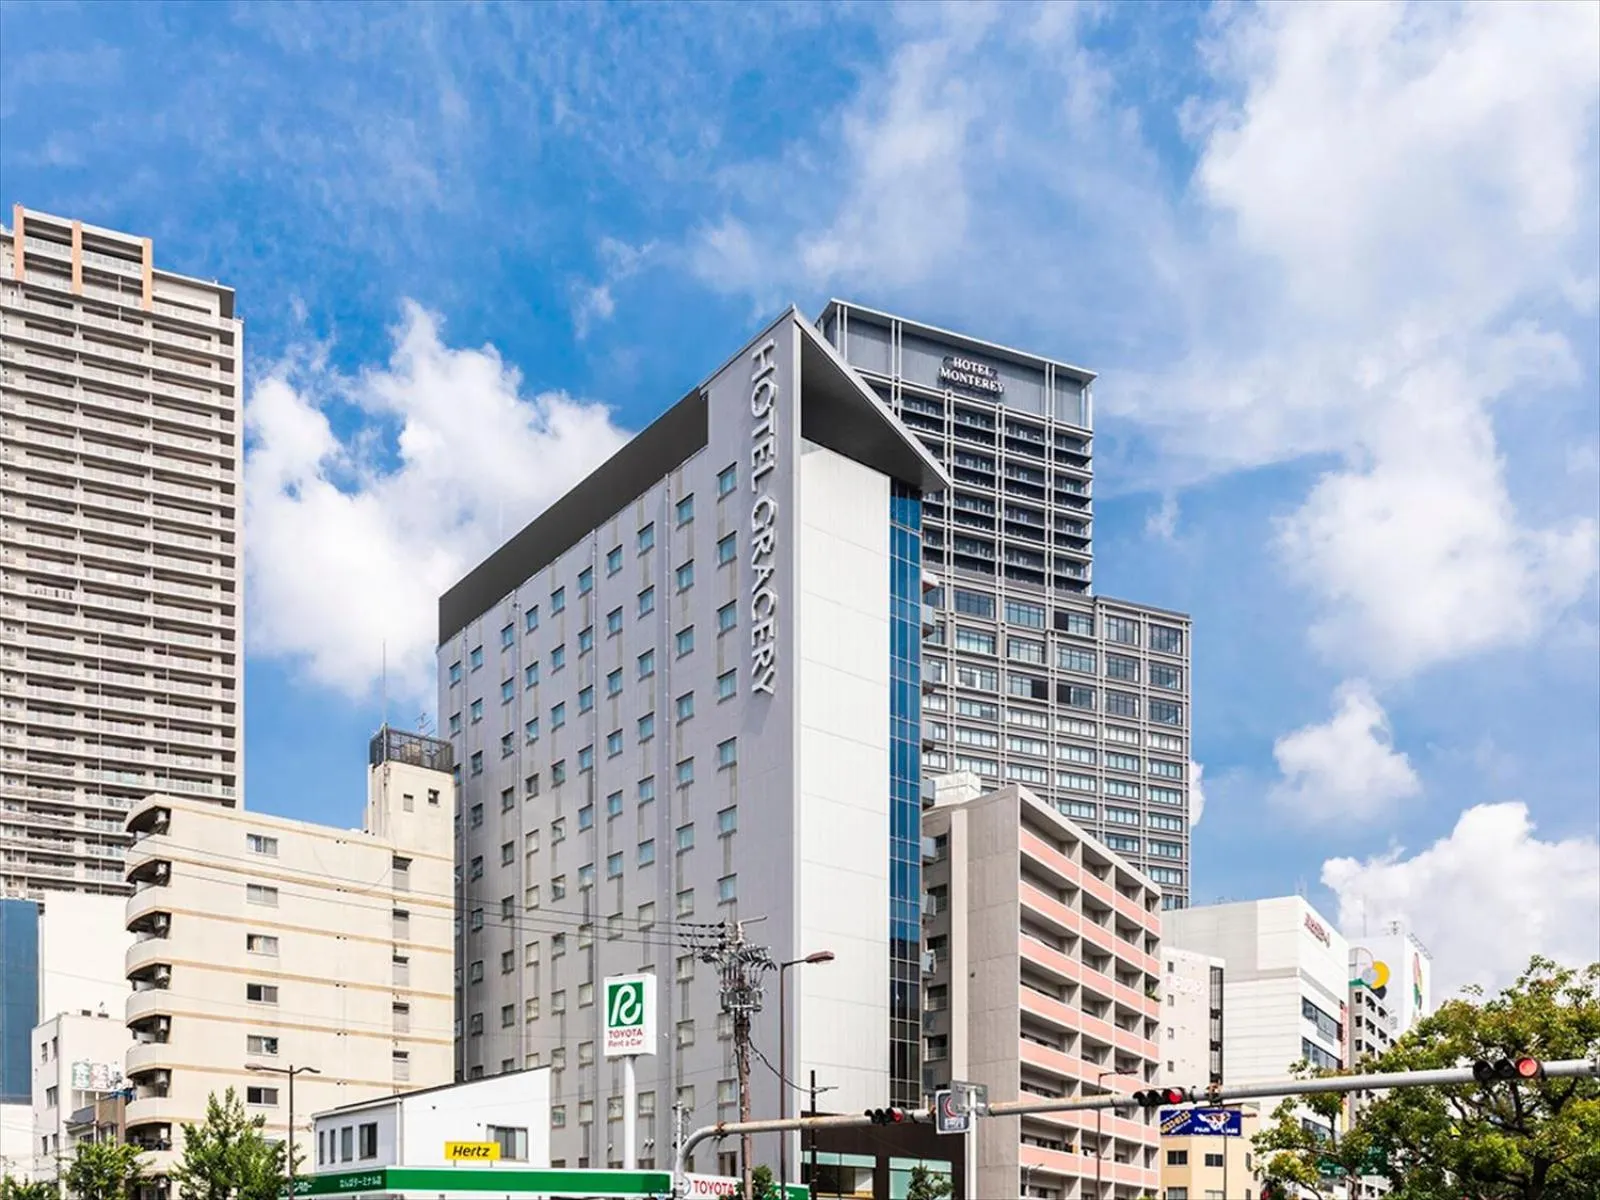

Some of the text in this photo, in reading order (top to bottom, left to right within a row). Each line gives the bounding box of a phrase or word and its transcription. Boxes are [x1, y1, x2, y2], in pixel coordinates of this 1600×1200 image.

[953, 357, 993, 377] HOTEL
[940, 367, 1005, 392] MONTEREY
[752, 338, 777, 695] HOTEL GRACERY
[608, 1028, 643, 1039] TOYOTA
[608, 1039, 624, 1048] Rent
[630, 1038, 642, 1046] Car
[452, 1145, 491, 1157] Hertz
[693, 1180, 736, 1196] TOYOTA
